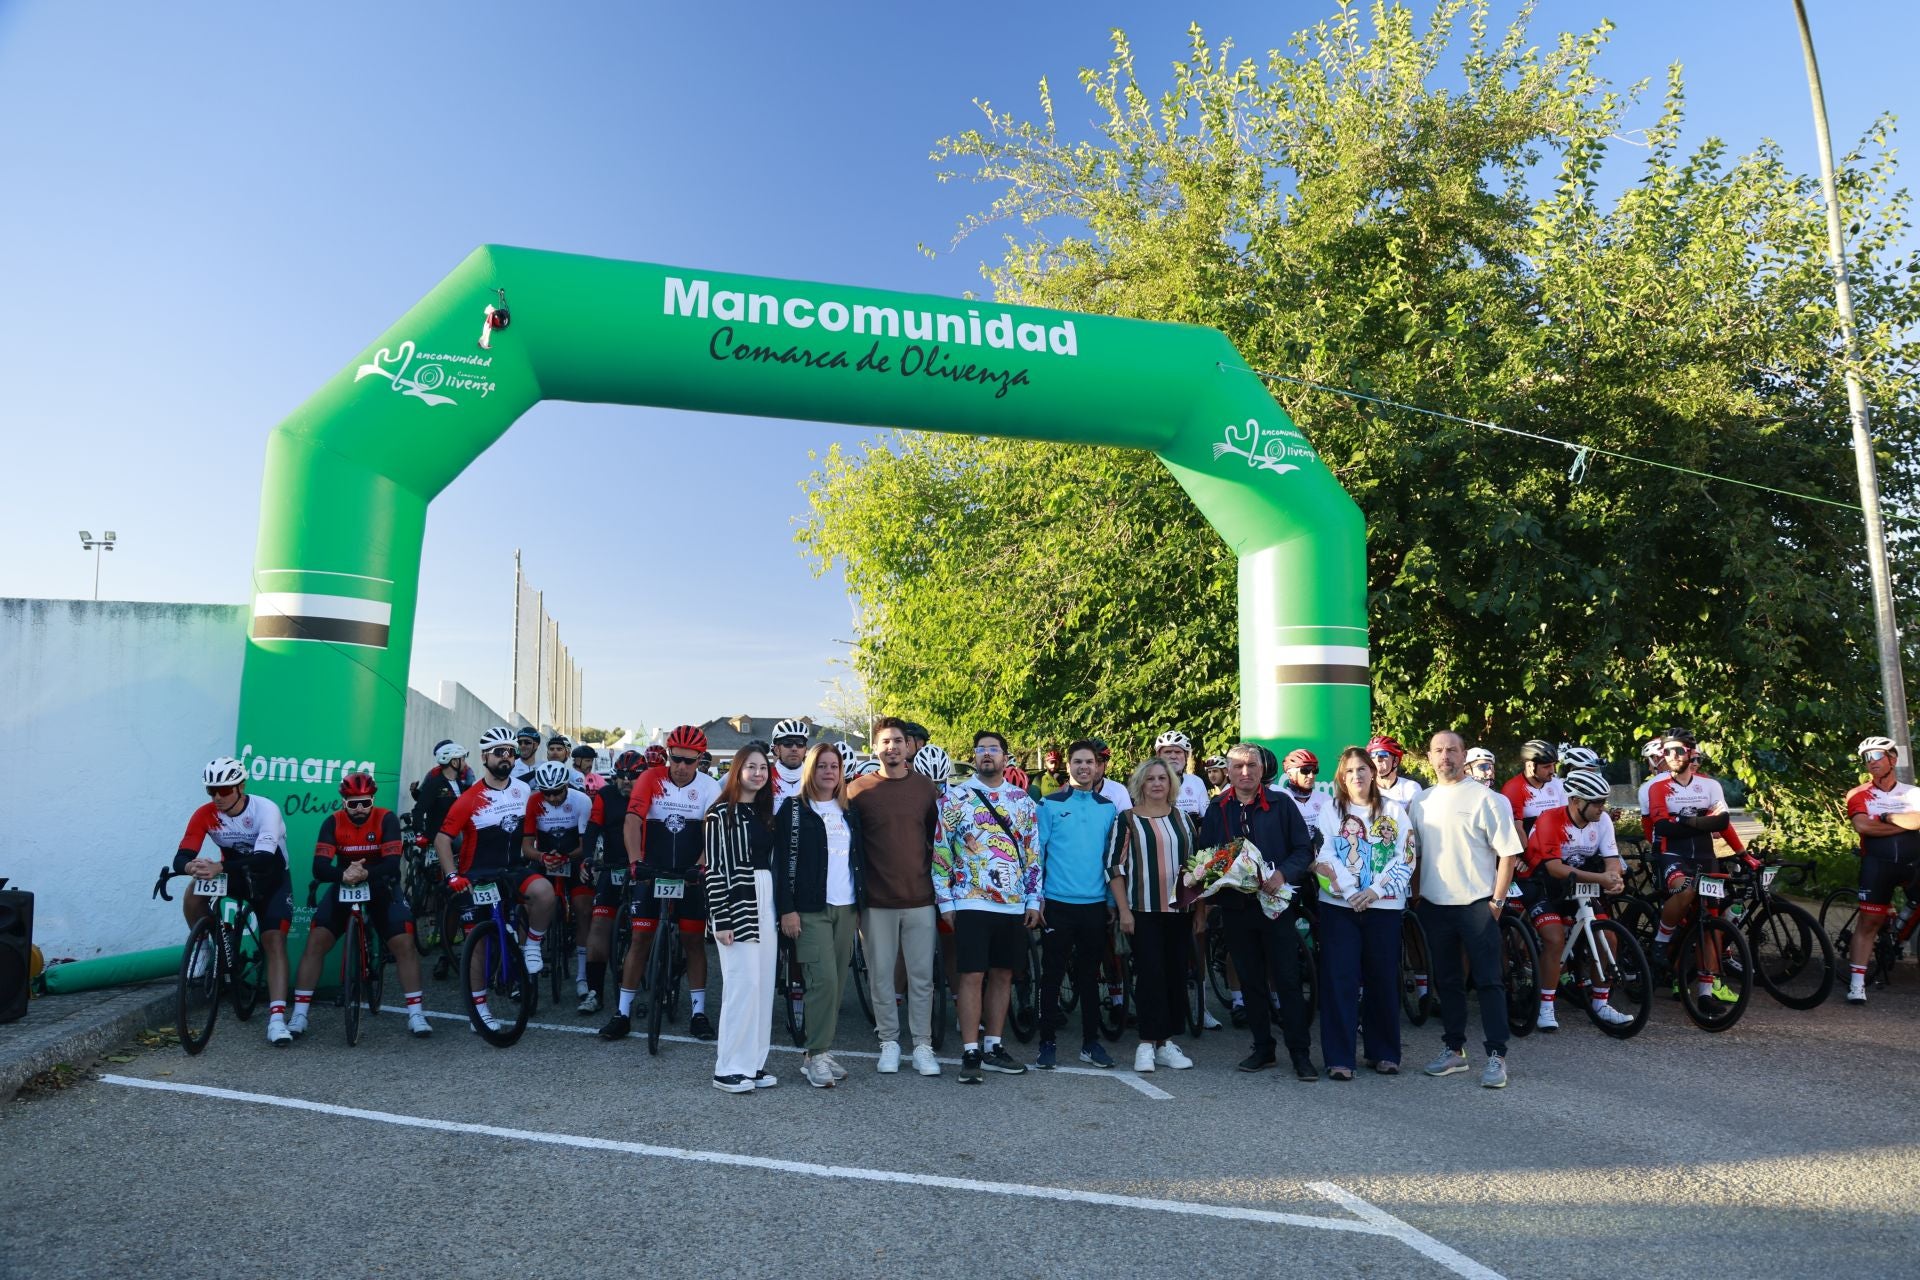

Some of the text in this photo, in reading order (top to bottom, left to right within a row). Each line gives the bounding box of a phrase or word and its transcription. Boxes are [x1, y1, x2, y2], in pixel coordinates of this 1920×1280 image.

[663, 276, 1078, 357] Mancomunidad
[709, 326, 1030, 399] Comarca de Olivenza
[792, 805, 800, 827] BIMBA
[791, 829, 799, 848] LOLA
[197, 880, 218, 893] 165
[657, 885, 676, 895] 157
[1578, 884, 1592, 895] 101
[1701, 882, 1718, 894] 102
[342, 889, 362, 900] 118
[474, 891, 492, 902] 153
